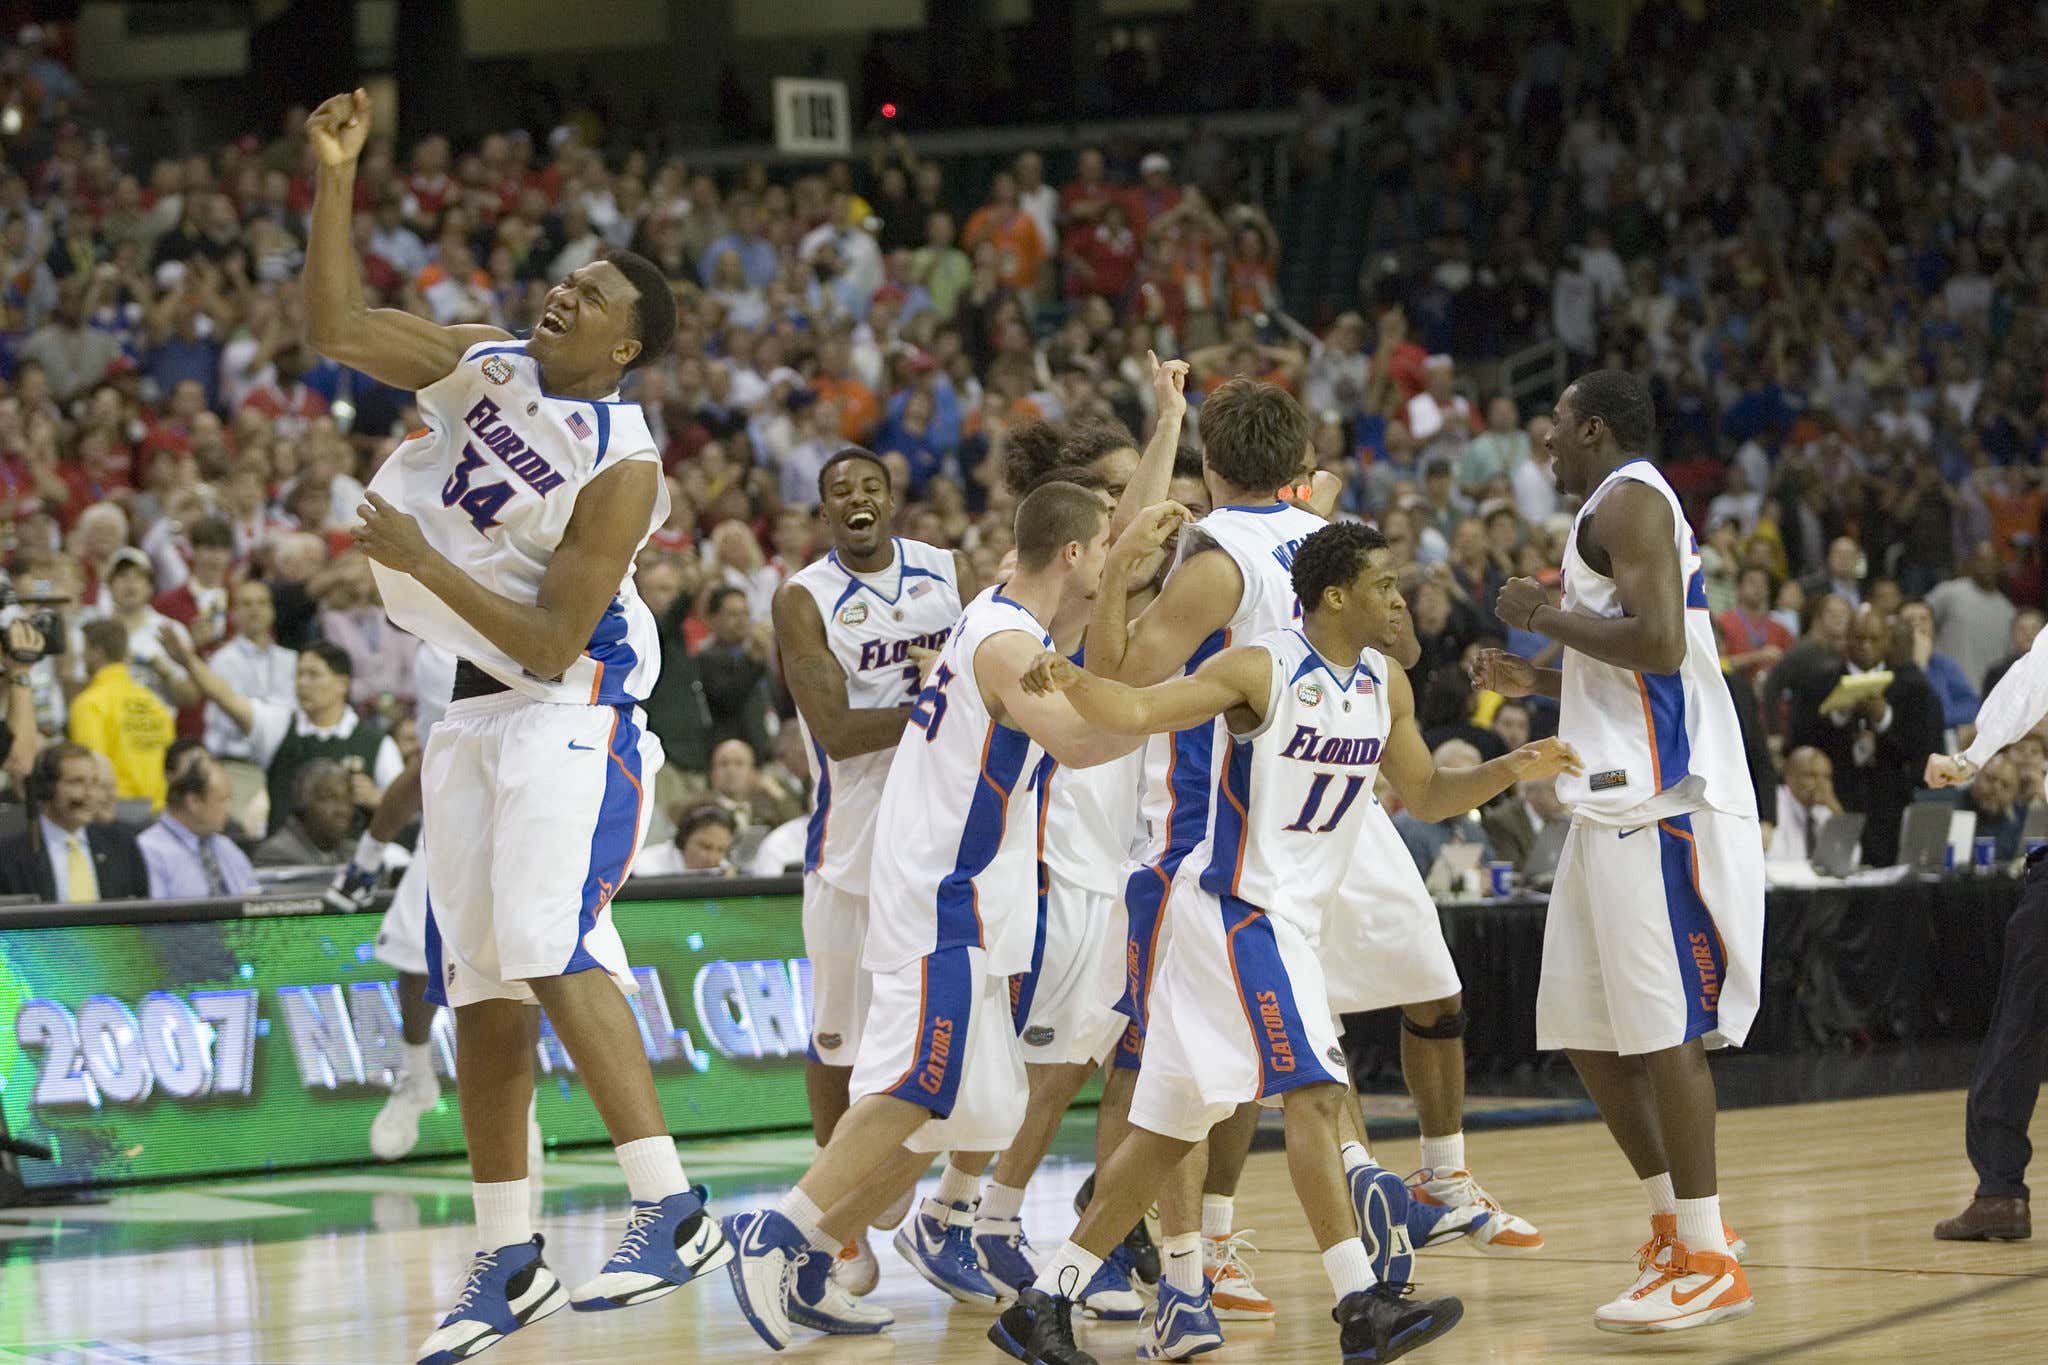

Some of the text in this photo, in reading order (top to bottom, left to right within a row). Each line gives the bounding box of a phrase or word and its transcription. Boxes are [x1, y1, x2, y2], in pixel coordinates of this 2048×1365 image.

[463, 393, 567, 500] FLORIDA
[441, 439, 518, 543] 34
[1281, 772, 1366, 834] 11
[1688, 932, 1720, 1012] GATORS
[16, 990, 259, 1109] 2007
[919, 1016, 953, 1095] GATORS
[1256, 991, 1296, 1072] GATORS
